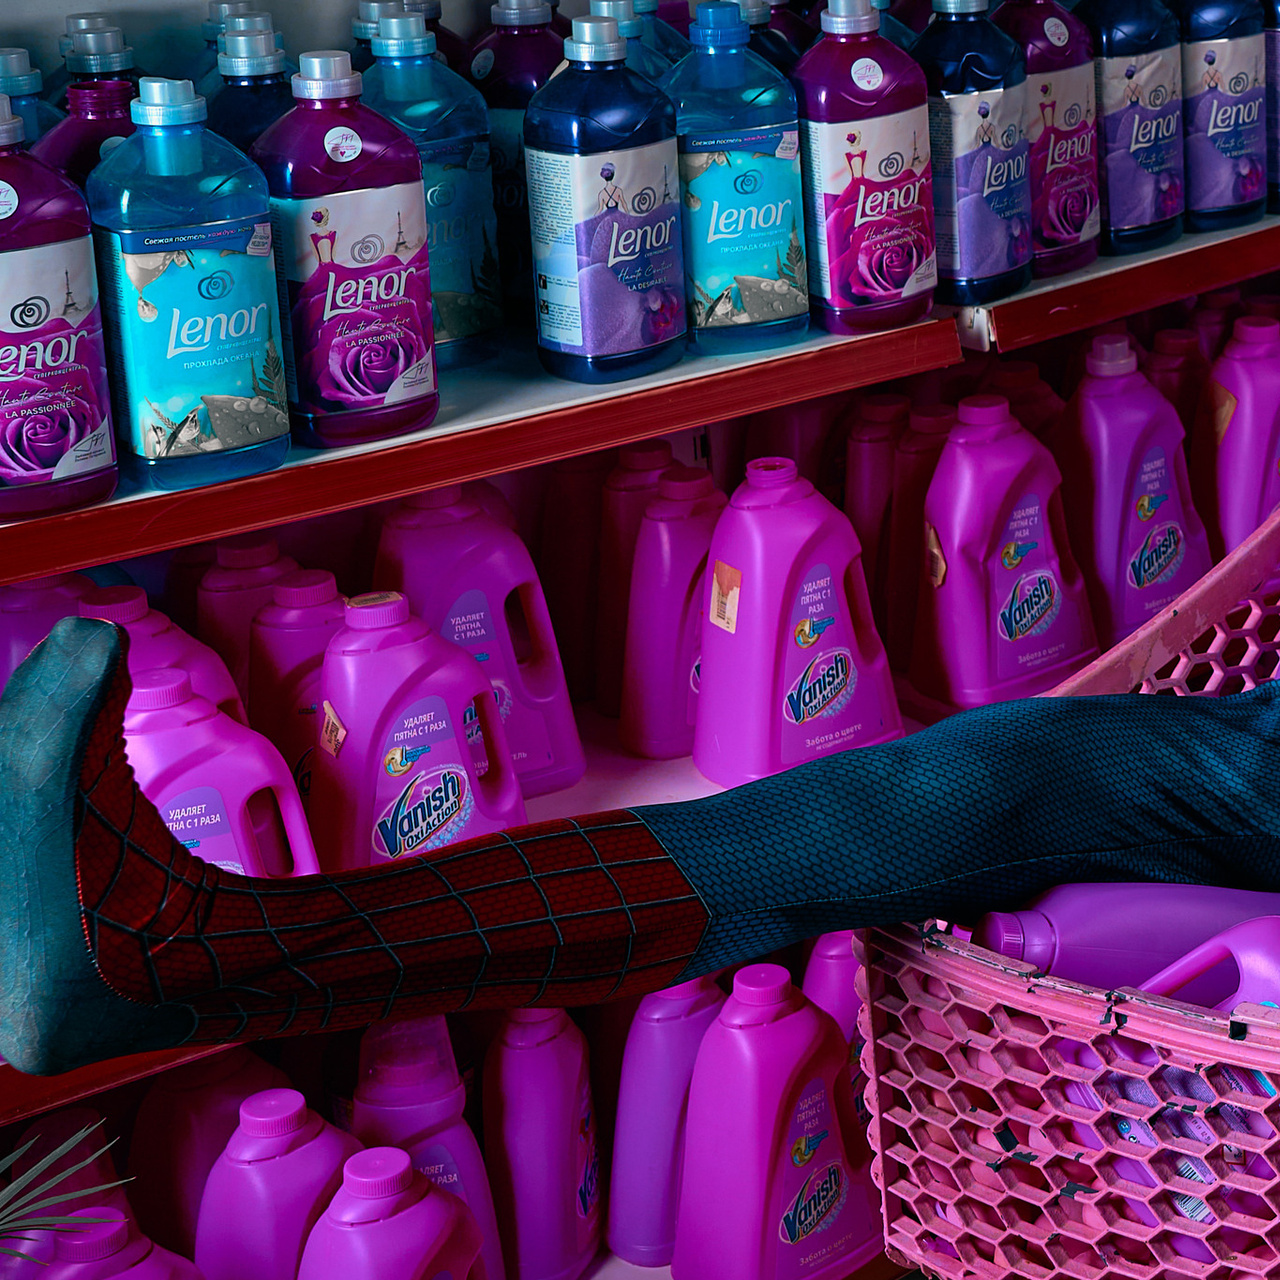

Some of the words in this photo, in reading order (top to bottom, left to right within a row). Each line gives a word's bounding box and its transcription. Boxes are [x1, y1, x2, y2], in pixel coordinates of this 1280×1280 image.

[1129, 109, 1180, 154] Lenor
[1207, 97, 1263, 138] Lenor
[1046, 128, 1094, 174] Lenor
[983, 151, 1028, 198] Lenor
[707, 199, 791, 244] Lenor
[854, 176, 928, 228] Lenor
[606, 216, 676, 268] Lenor
[323, 266, 416, 322] Lenor
[166, 302, 267, 359] Lenor
[345, 340, 357, 349] LA
[0, 329, 88, 383] enor
[5, 409, 17, 419] LA
[1130, 525, 1180, 590] Vanish
[803, 577, 831, 593] УДАЛЯЕТ
[1000, 573, 1054, 641] Vanish
[450, 611, 485, 625] УДАЛЯЕТ
[455, 621, 482, 632] ПЯТНА
[466, 628, 486, 639] РАЗА
[787, 652, 849, 725] Vanish
[394, 729, 418, 742] ПЯТНА
[418, 728, 424, 736] С
[424, 726, 429, 735] 1
[429, 720, 447, 733] РАЗА
[404, 712, 435, 729] УДАЛЯЕТ
[806, 733, 834, 748] Забота
[841, 723, 862, 736] цвете
[168, 803, 207, 820] УДАЛЯЕТ
[200, 813, 221, 826] РАЗА
[377, 771, 461, 859] Vanish
[783, 1165, 840, 1245] Vanish
